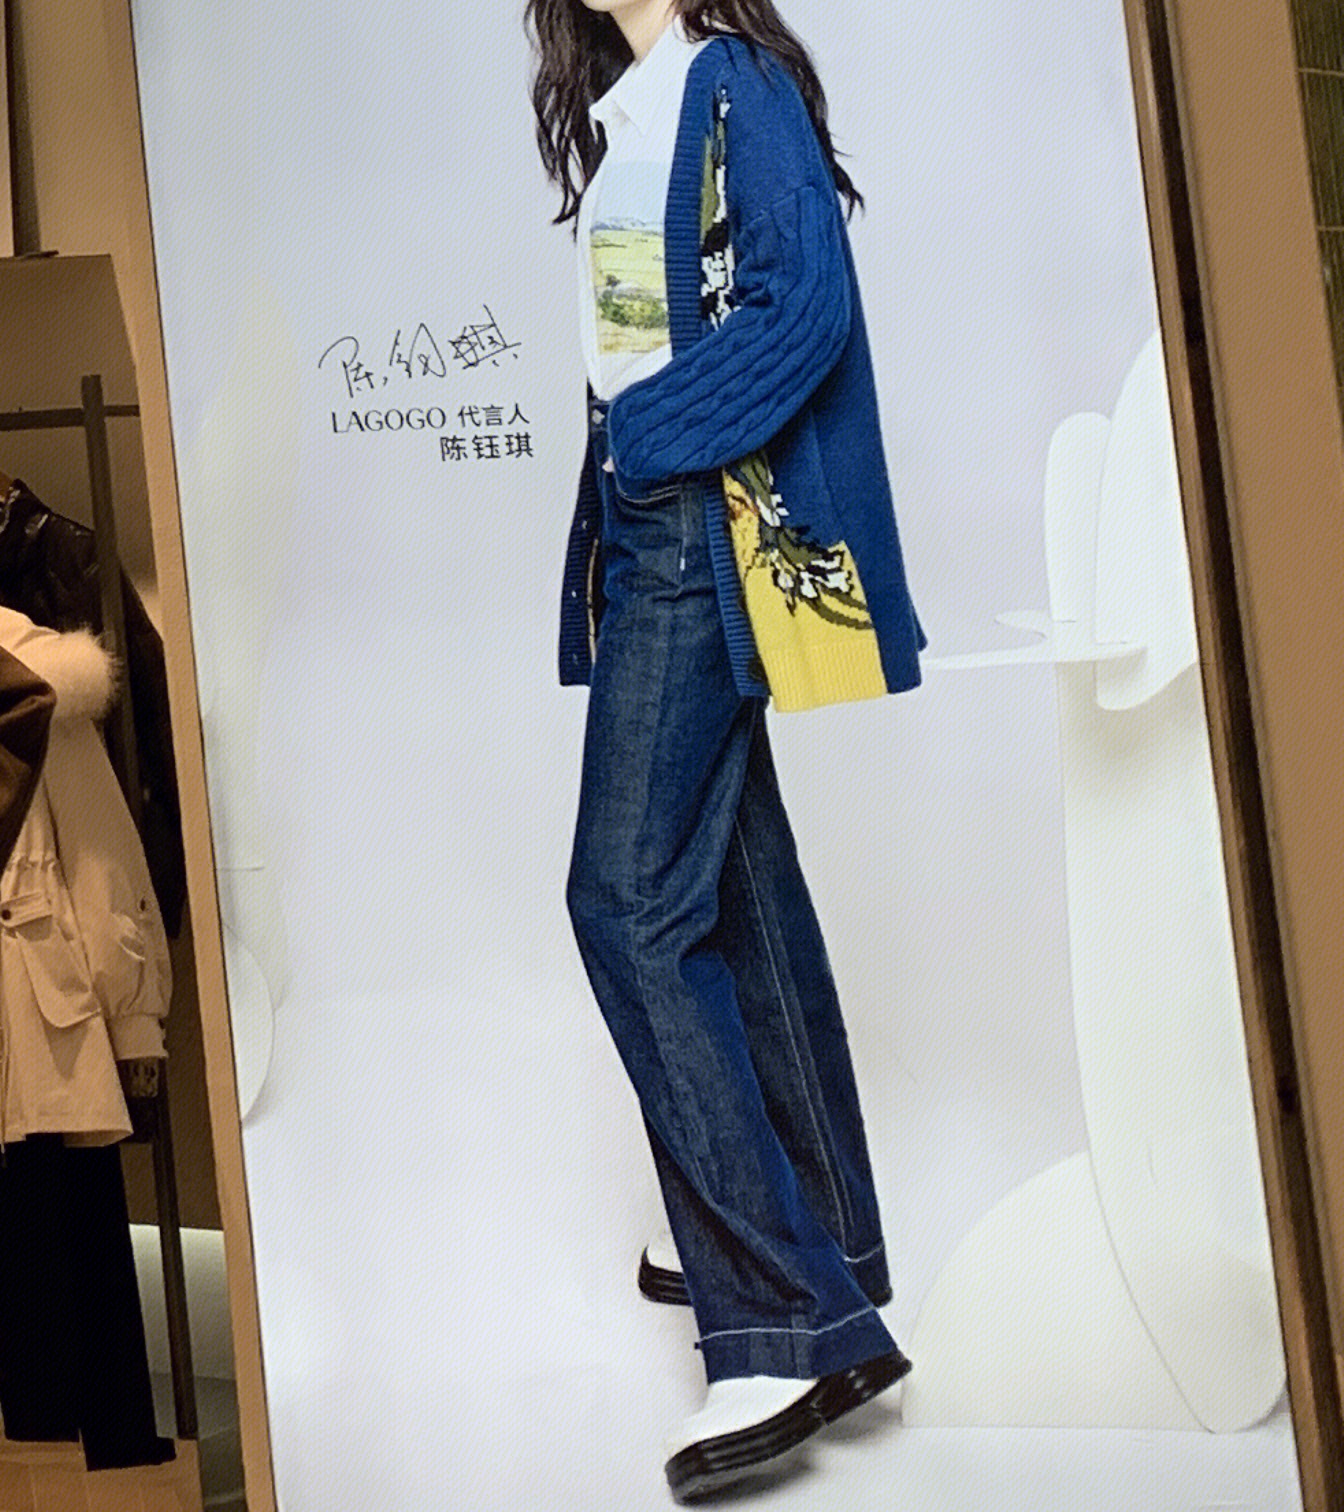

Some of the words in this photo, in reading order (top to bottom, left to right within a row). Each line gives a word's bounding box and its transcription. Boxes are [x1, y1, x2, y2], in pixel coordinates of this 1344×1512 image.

[331, 406, 447, 434] LAGOGO
[457, 402, 531, 428] 代言人
[439, 432, 534, 462] 陈钰琪
